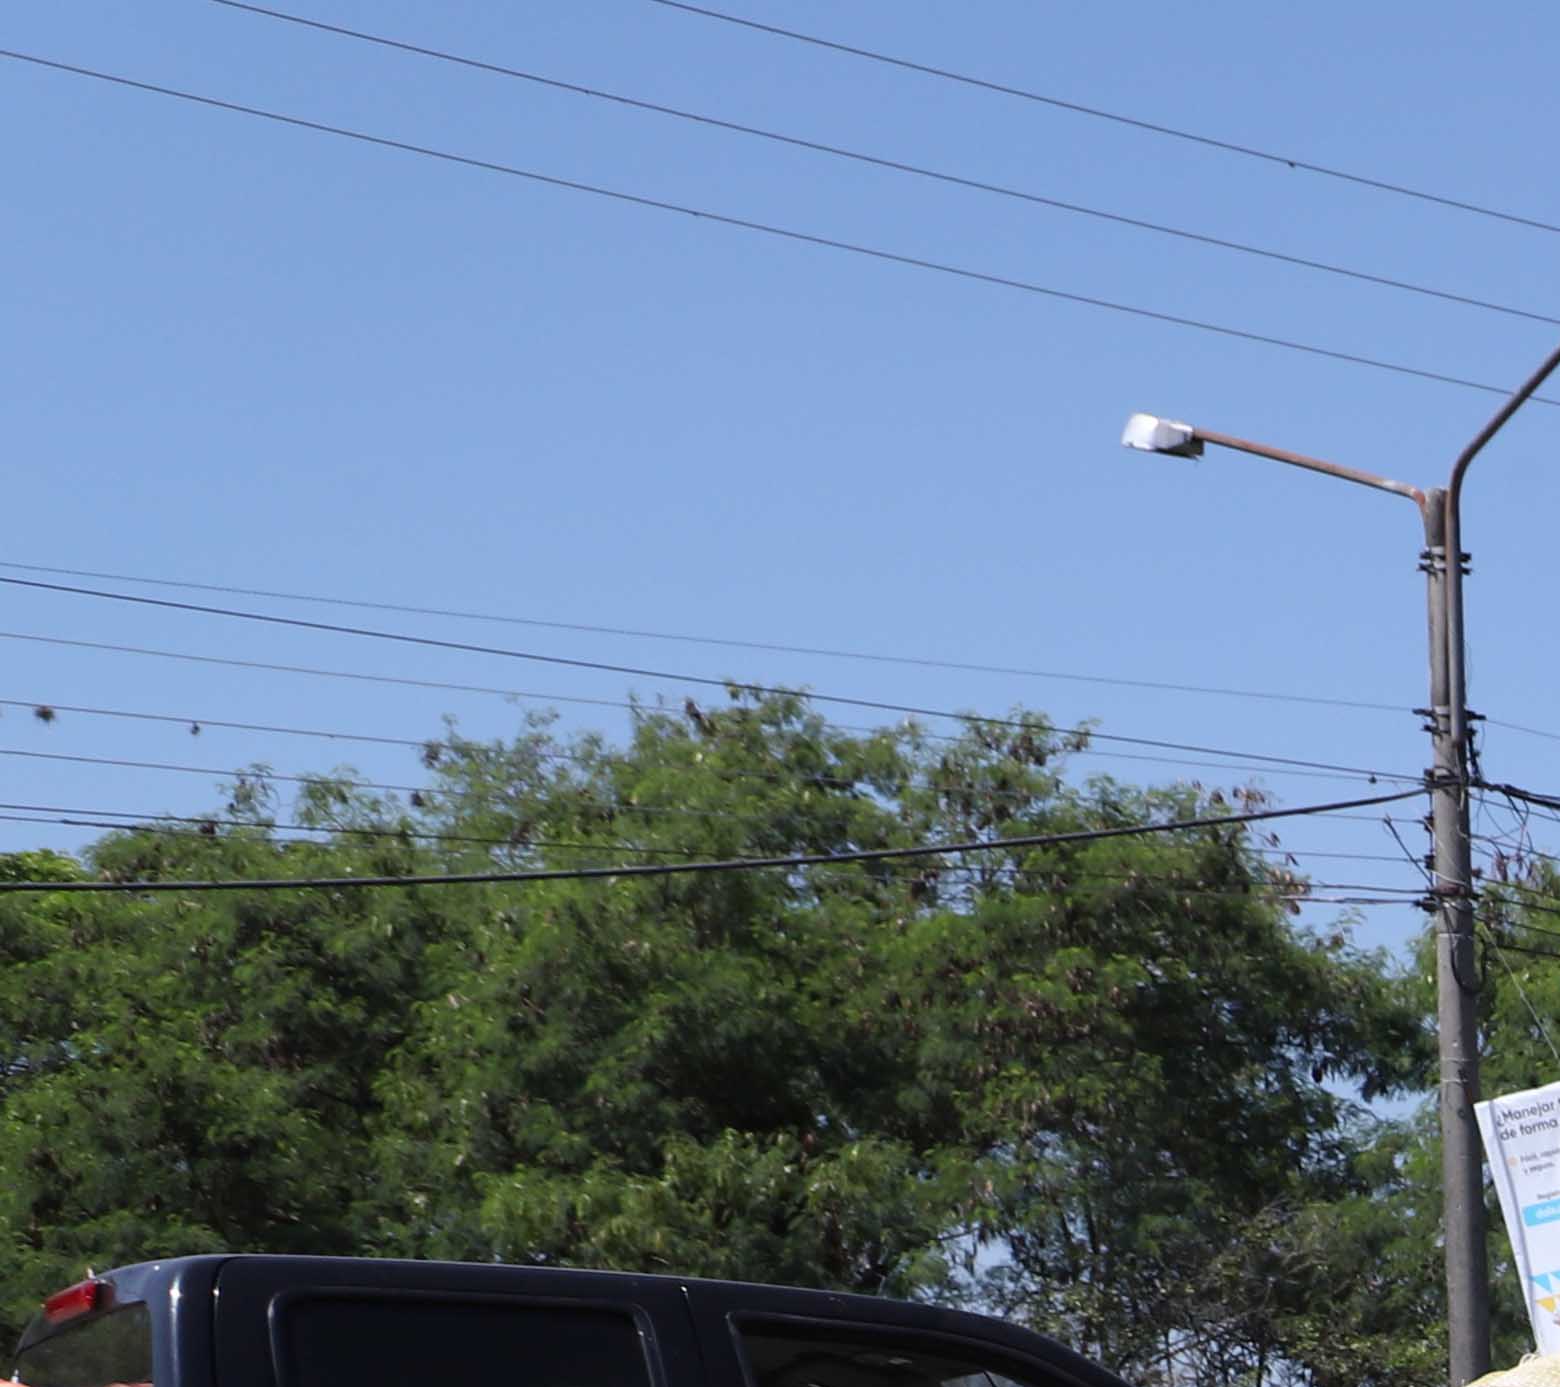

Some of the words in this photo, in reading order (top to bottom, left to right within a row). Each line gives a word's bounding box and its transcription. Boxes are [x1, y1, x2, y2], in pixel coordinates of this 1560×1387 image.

[1496, 1101, 1555, 1127] ¿Manejar
[1500, 1128, 1517, 1141] de
[1520, 1117, 1558, 1135] forma
